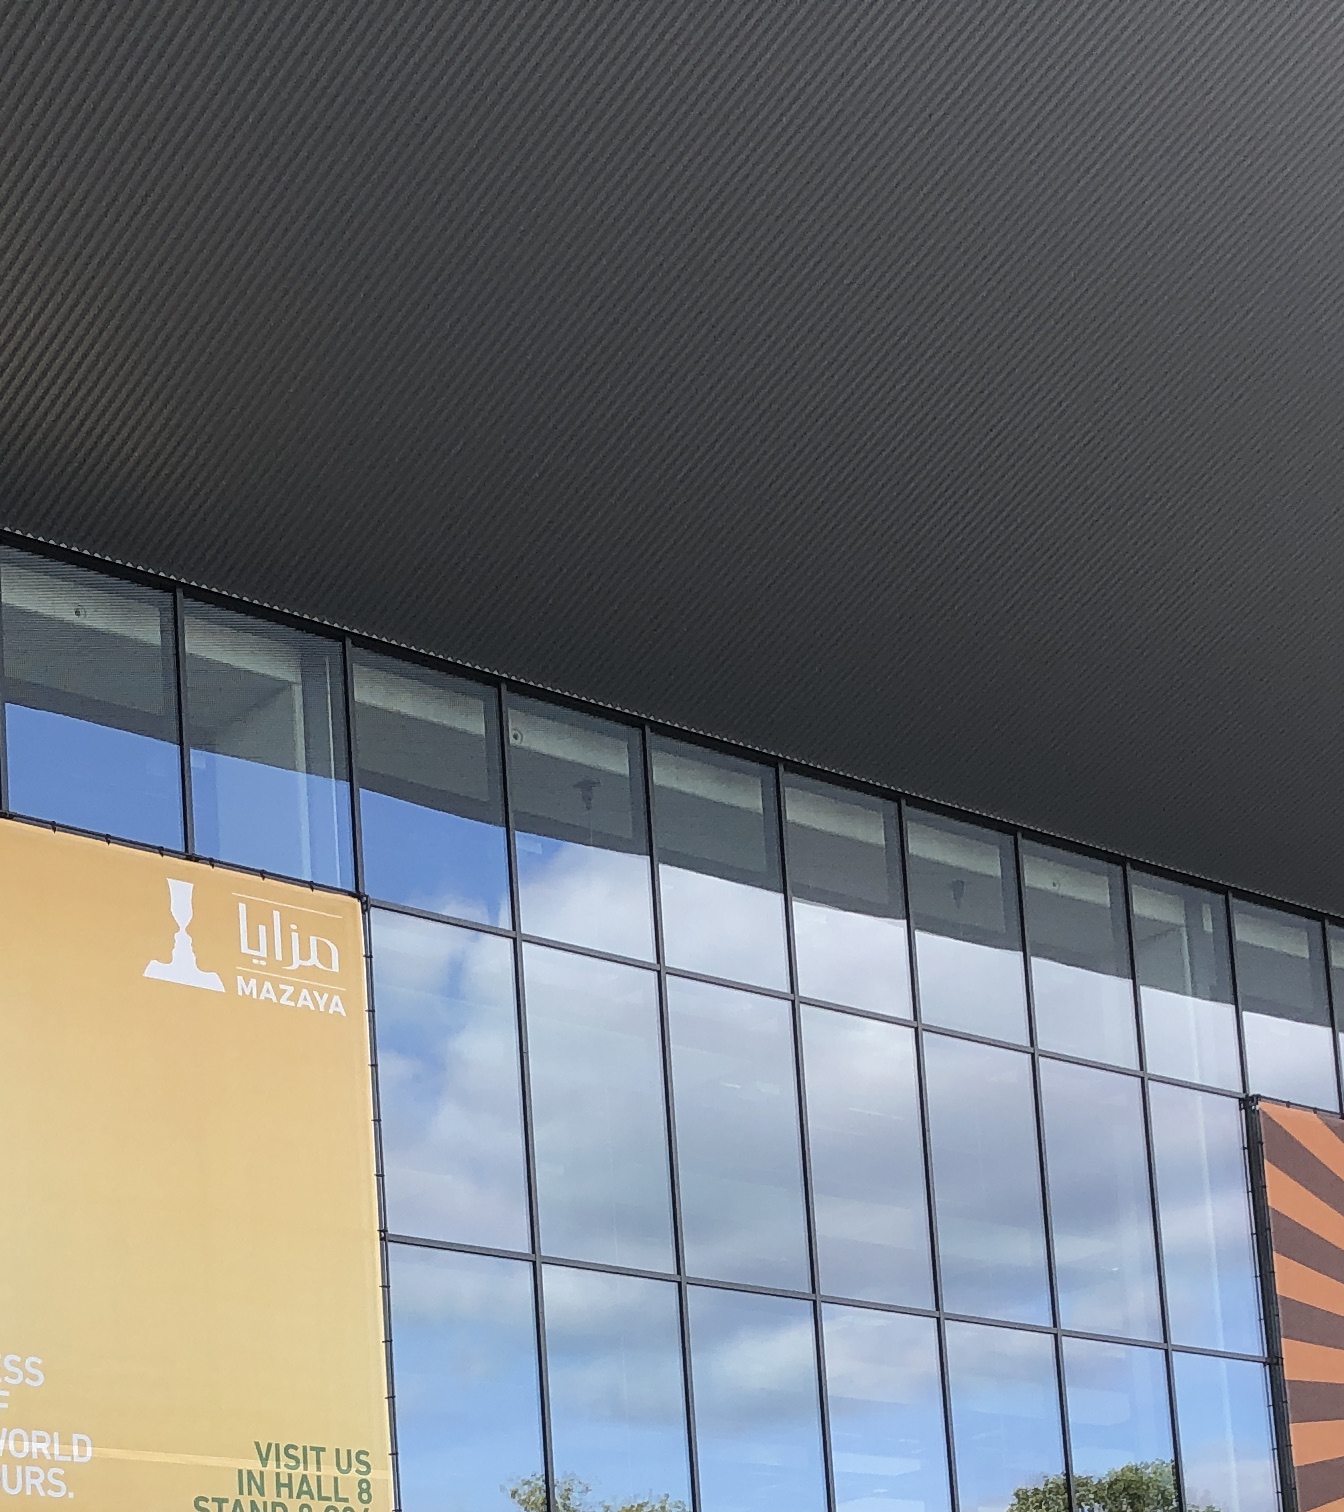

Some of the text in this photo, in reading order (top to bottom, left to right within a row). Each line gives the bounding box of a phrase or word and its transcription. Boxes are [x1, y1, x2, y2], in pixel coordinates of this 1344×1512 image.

[238, 902, 340, 973] مزايا
[236, 975, 347, 1017] MAZAYA
[253, 1440, 372, 1476] VISIT US
[238, 1468, 373, 1505] IN HALL 8
